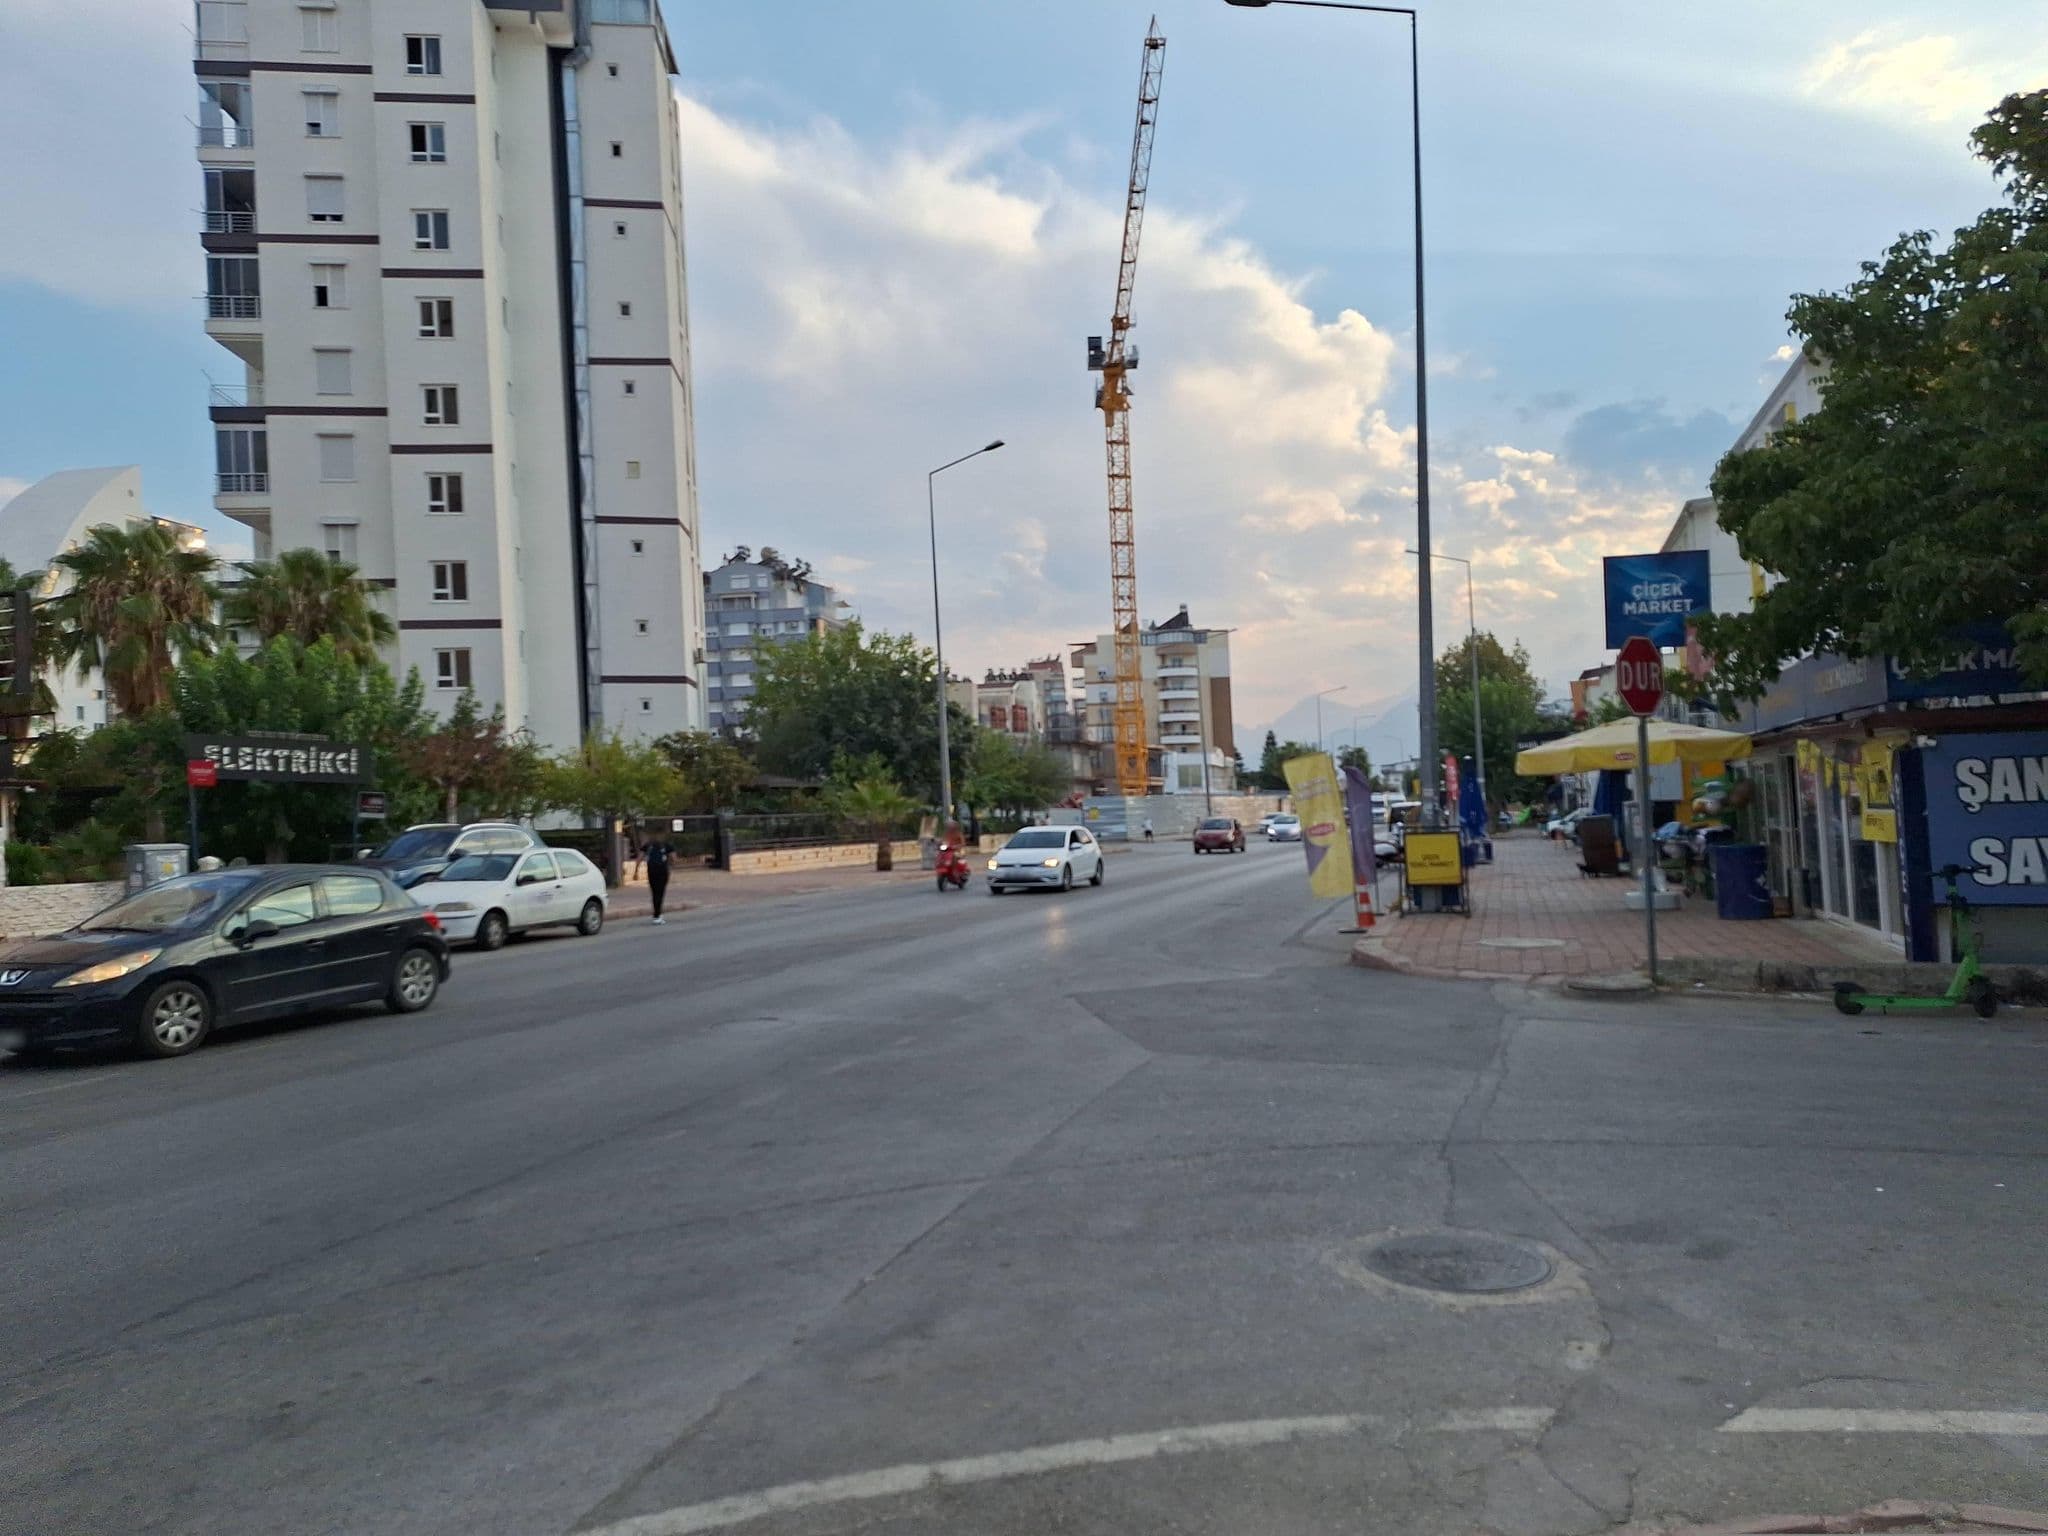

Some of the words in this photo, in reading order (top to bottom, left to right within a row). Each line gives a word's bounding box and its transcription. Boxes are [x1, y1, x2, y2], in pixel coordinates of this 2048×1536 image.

[1631, 580, 1684, 600] ÇİÇEK
[1623, 598, 1694, 616] MARKET
[1621, 661, 1661, 691] DUR
[1970, 837, 2048, 886] SA
